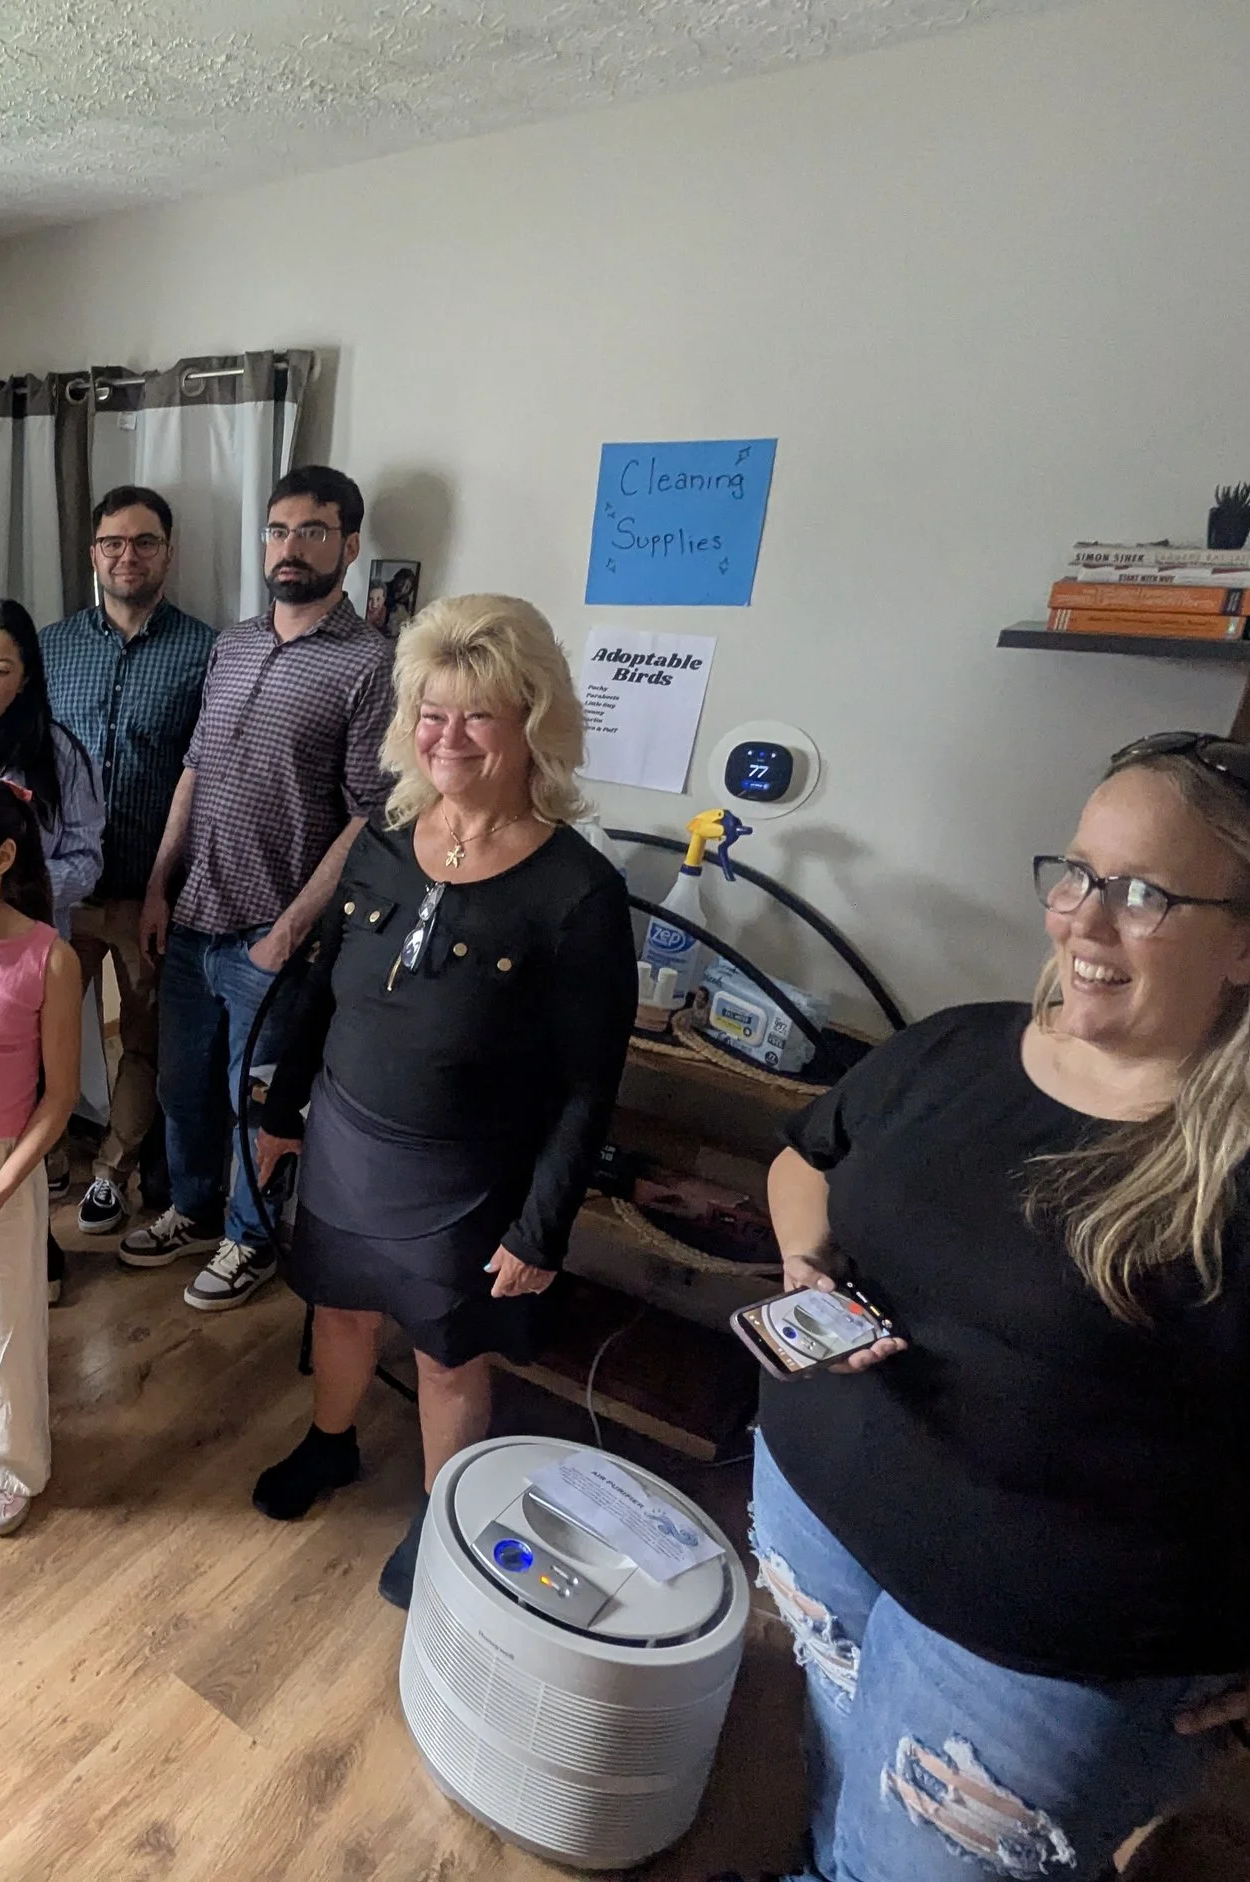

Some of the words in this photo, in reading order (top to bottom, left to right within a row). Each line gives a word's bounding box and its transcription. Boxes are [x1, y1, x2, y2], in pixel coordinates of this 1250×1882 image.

[620, 457, 745, 500] Cleaning
[611, 517, 722, 558] Supplies
[1074, 552, 1111, 562] SIMON
[1113, 552, 1145, 562] SINEK
[591, 647, 703, 671] Adoptable
[612, 667, 674, 686] Birds
[748, 764, 770, 779] 77
[591, 1471, 606, 1481] AIR
[605, 1480, 645, 1509] PURIFIER
